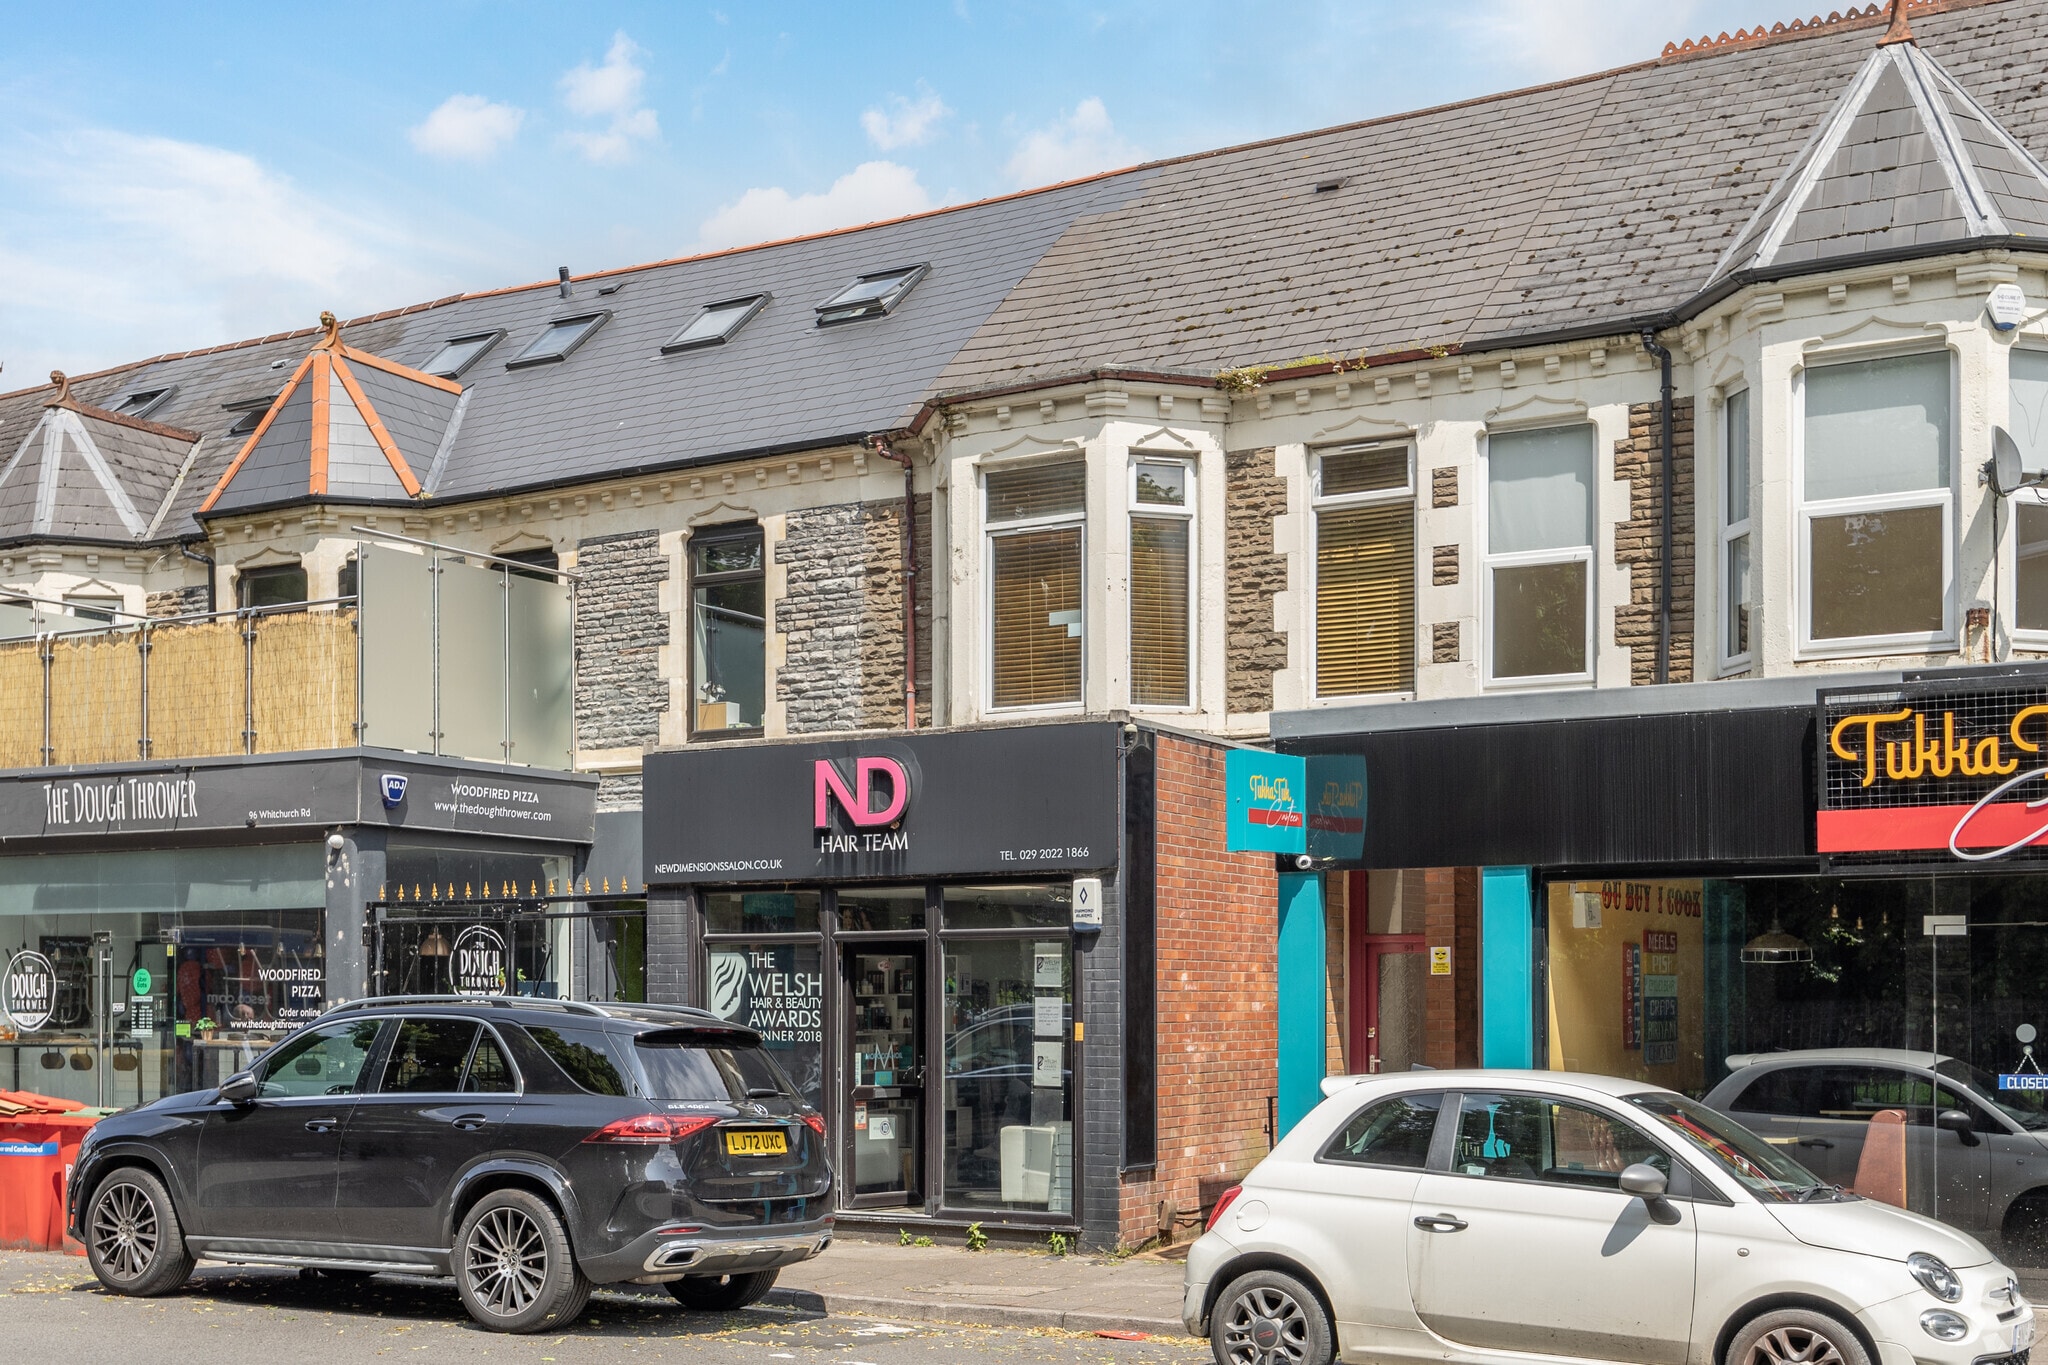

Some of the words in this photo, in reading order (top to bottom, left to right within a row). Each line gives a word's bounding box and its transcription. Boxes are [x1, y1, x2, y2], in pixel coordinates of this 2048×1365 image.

[1830, 708, 2019, 788] Tukka
[388, 780, 405, 790] ADJ
[451, 783, 511, 801] WOODFIRED
[512, 789, 539, 804] PIZZA
[814, 756, 909, 829] ND
[1250, 775, 1276, 800] Tukka
[1274, 778, 1292, 803] Tuk
[43, 784, 69, 825] THE
[74, 781, 125, 823] DOUGH
[129, 778, 198, 820] THROWER
[248, 811, 258, 819] 96
[259, 808, 299, 819] Whitchurch
[300, 808, 311, 817] Rd
[434, 800, 552, 822] www.thedoughthrower.com
[820, 834, 858, 854] HAIR
[863, 832, 909, 852] TEAM
[1000, 850, 1017, 861] TEL.
[1019, 849, 1036, 860] 029
[1039, 848, 1063, 859] 2022
[1065, 847, 1089, 858] 1866
[654, 859, 783, 875] NEWDIMENSIONSSALON.CO.UK
[1601, 881, 1621, 910] OU
[1625, 882, 1651, 912] BUY
[1667, 887, 1701, 918] COOK
[1648, 933, 1676, 951] MEALS
[24, 965, 34, 973] THE
[460, 949, 499, 976] DOUGH
[748, 952, 775, 969] THE
[258, 969, 321, 981] WOODFIRED
[460, 977, 500, 988] THROWER
[11, 973, 47, 999] DOUGH
[291, 986, 322, 998] PIZZA
[747, 973, 822, 997] WELSH
[12, 999, 47, 1010] THROWER
[750, 997, 773, 1009] HAIR
[775, 997, 783, 1009] &
[785, 997, 822, 1009] BEAUTY
[278, 1008, 299, 1017] Order
[300, 1008, 322, 1017] online
[748, 1010, 821, 1028] AWARDS
[759, 1030, 795, 1042] NNER
[797, 1030, 822, 1042] 2018
[2007, 1076, 2048, 1090] CLOSED
[14, 1145, 43, 1153] Cardboard
[731, 1135, 761, 1151] LJ72
[762, 1134, 782, 1149] UXC
